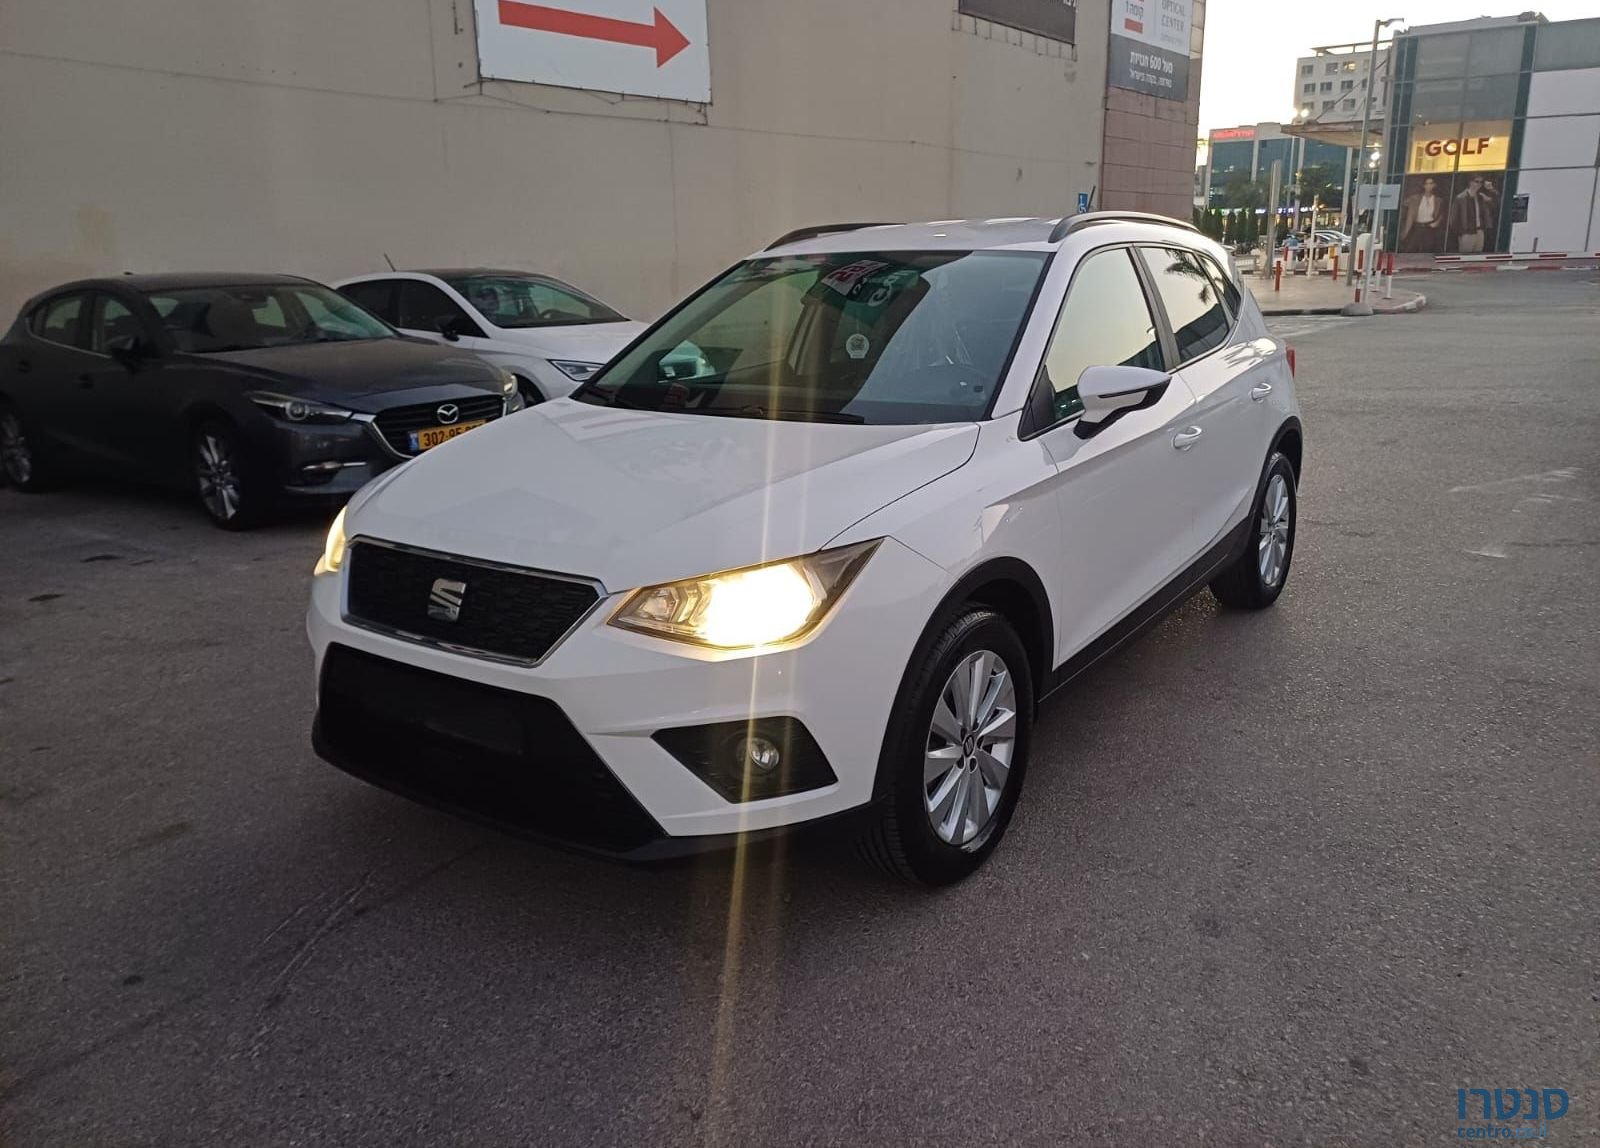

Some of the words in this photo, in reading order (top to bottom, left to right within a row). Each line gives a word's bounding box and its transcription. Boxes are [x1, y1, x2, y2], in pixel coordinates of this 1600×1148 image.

[1161, 0, 1185, 17] OPTICAL
[1161, 14, 1185, 32] CENTER
[1150, 54, 1162, 71] 600
[1424, 136, 1490, 157] GOLF
